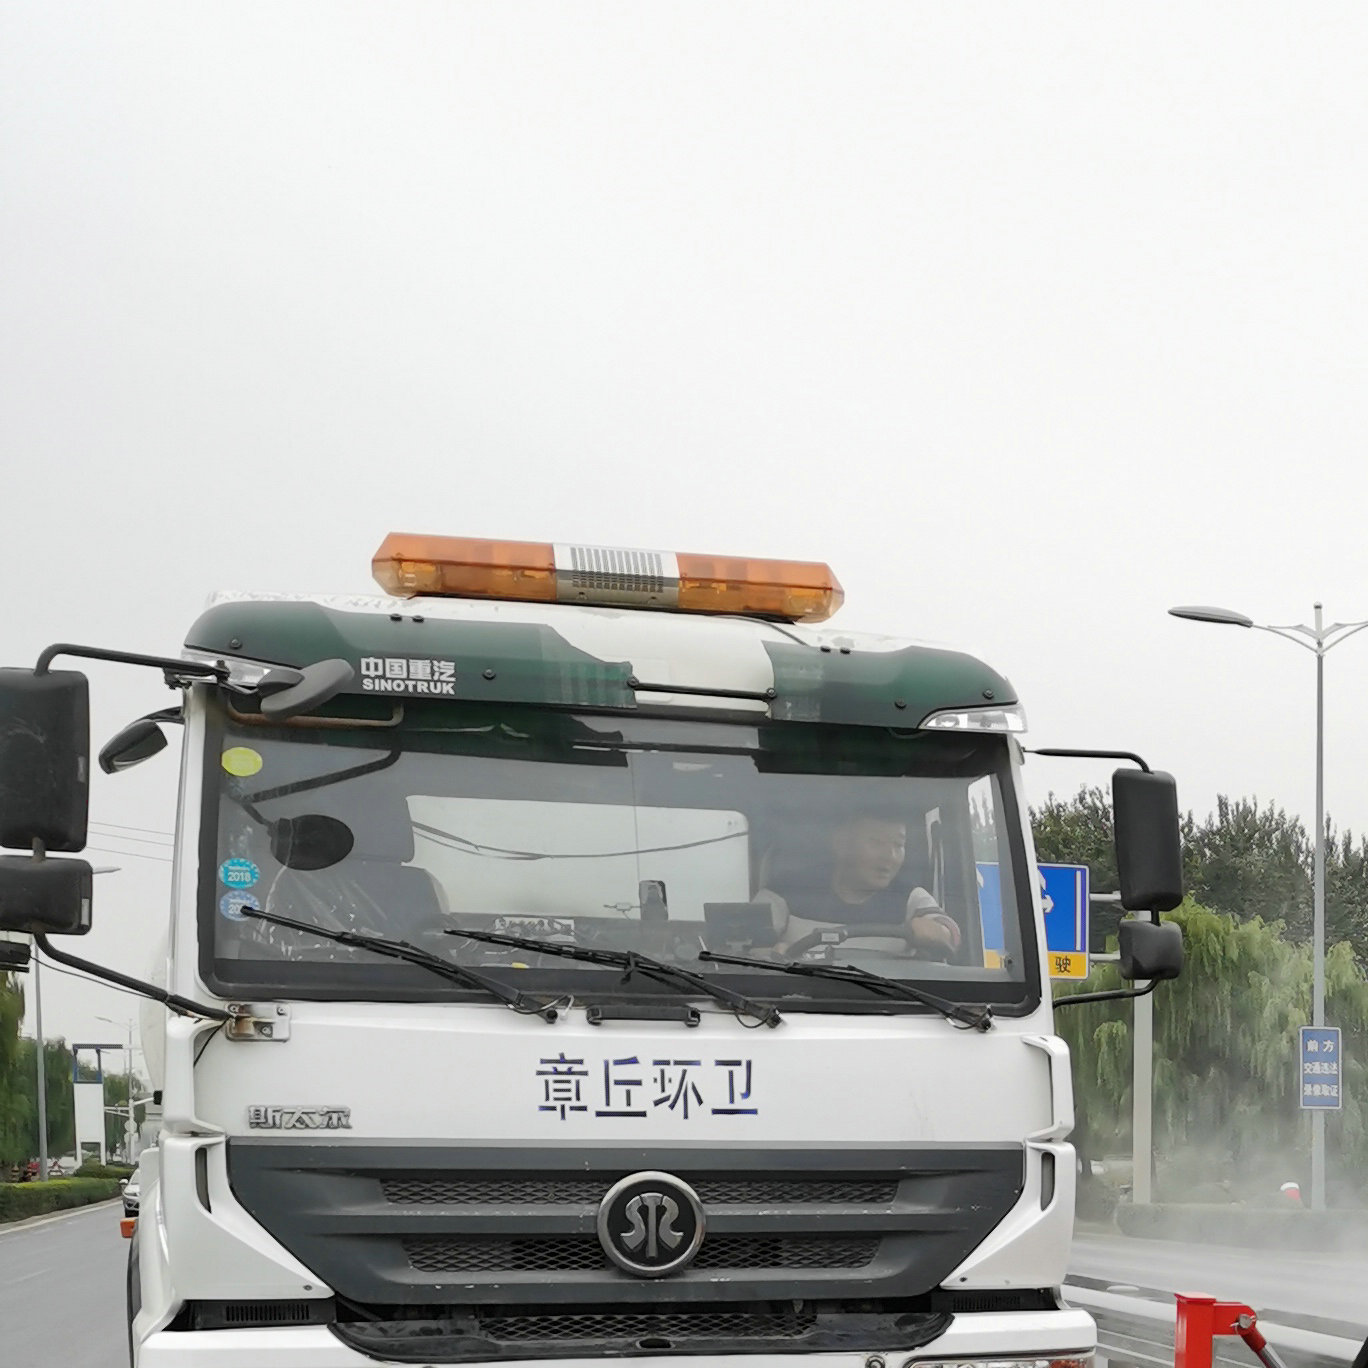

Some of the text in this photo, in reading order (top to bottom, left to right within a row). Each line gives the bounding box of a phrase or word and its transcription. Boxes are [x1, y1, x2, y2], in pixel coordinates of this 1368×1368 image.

[361, 657, 456, 681] 中国重汽
[362, 678, 455, 695] SINOTRUK
[1055, 955, 1071, 973] 驶
[1306, 1039, 1335, 1053] 前方
[536, 1052, 759, 1121] 章丘环卫
